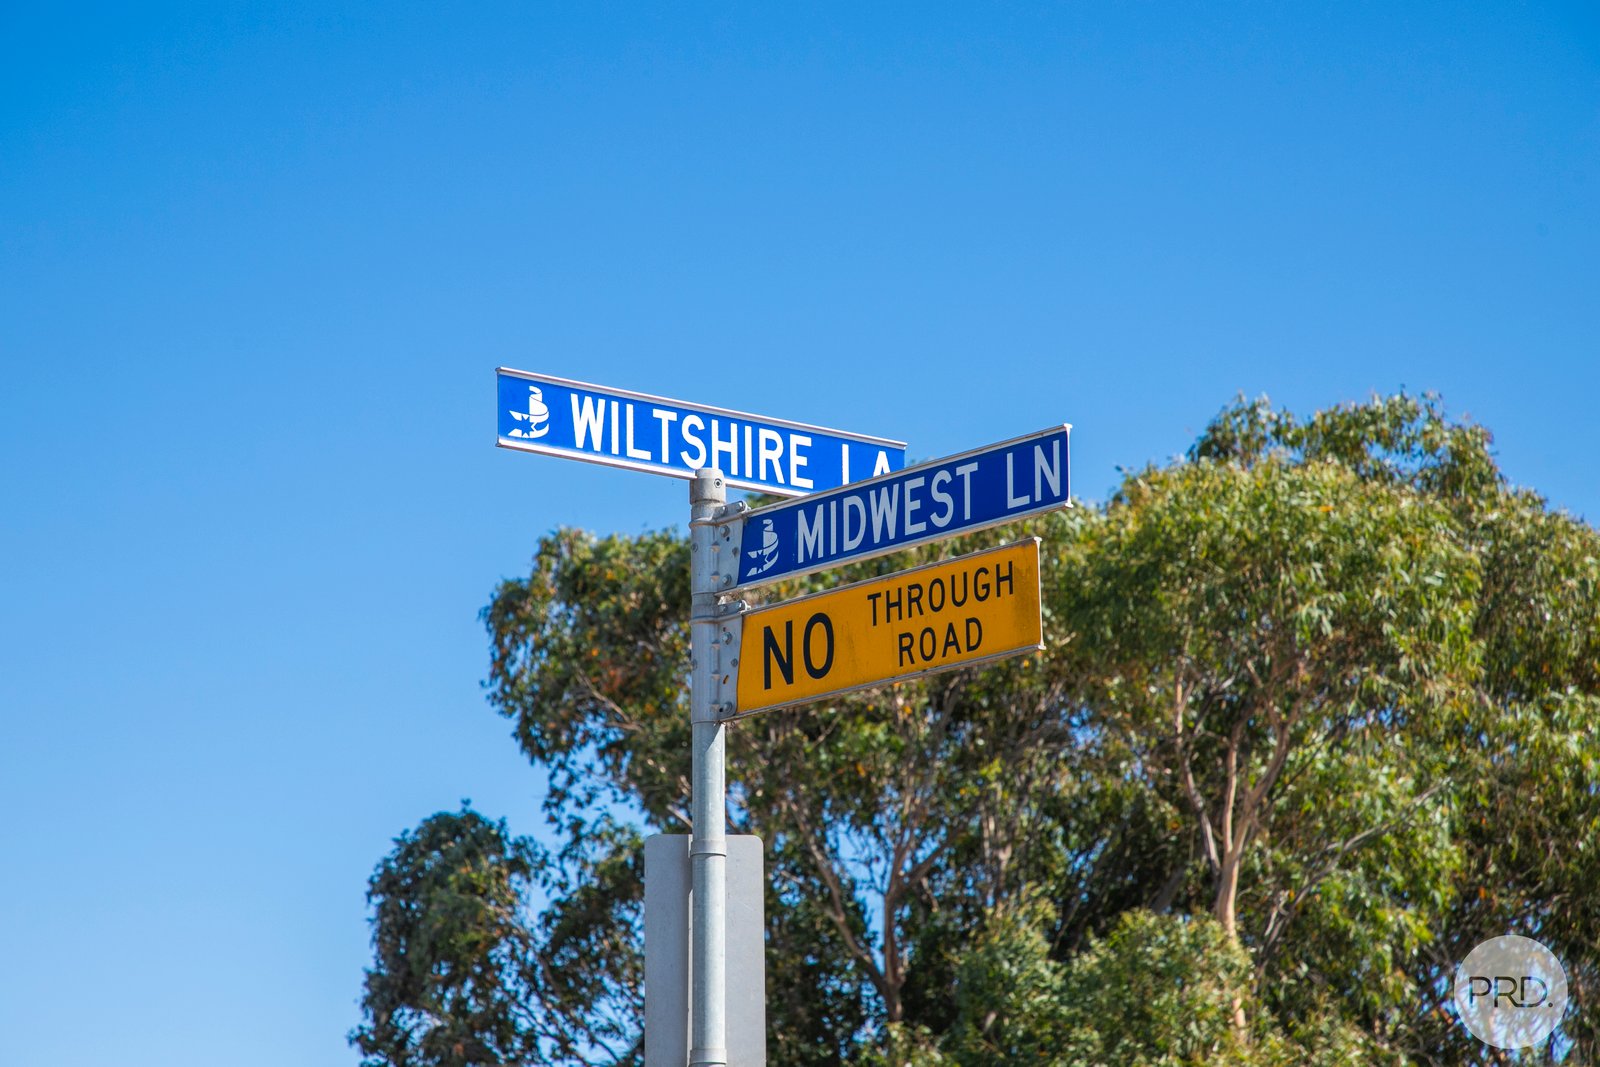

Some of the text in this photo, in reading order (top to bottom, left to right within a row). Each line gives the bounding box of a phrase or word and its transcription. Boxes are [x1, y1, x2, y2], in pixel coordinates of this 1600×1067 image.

[570, 392, 814, 490] WILTSHIRE
[797, 439, 1061, 564] MIDWEST LN
[867, 560, 1015, 627] THROUGH
[763, 611, 835, 690] NO
[898, 616, 984, 667] ROAD
